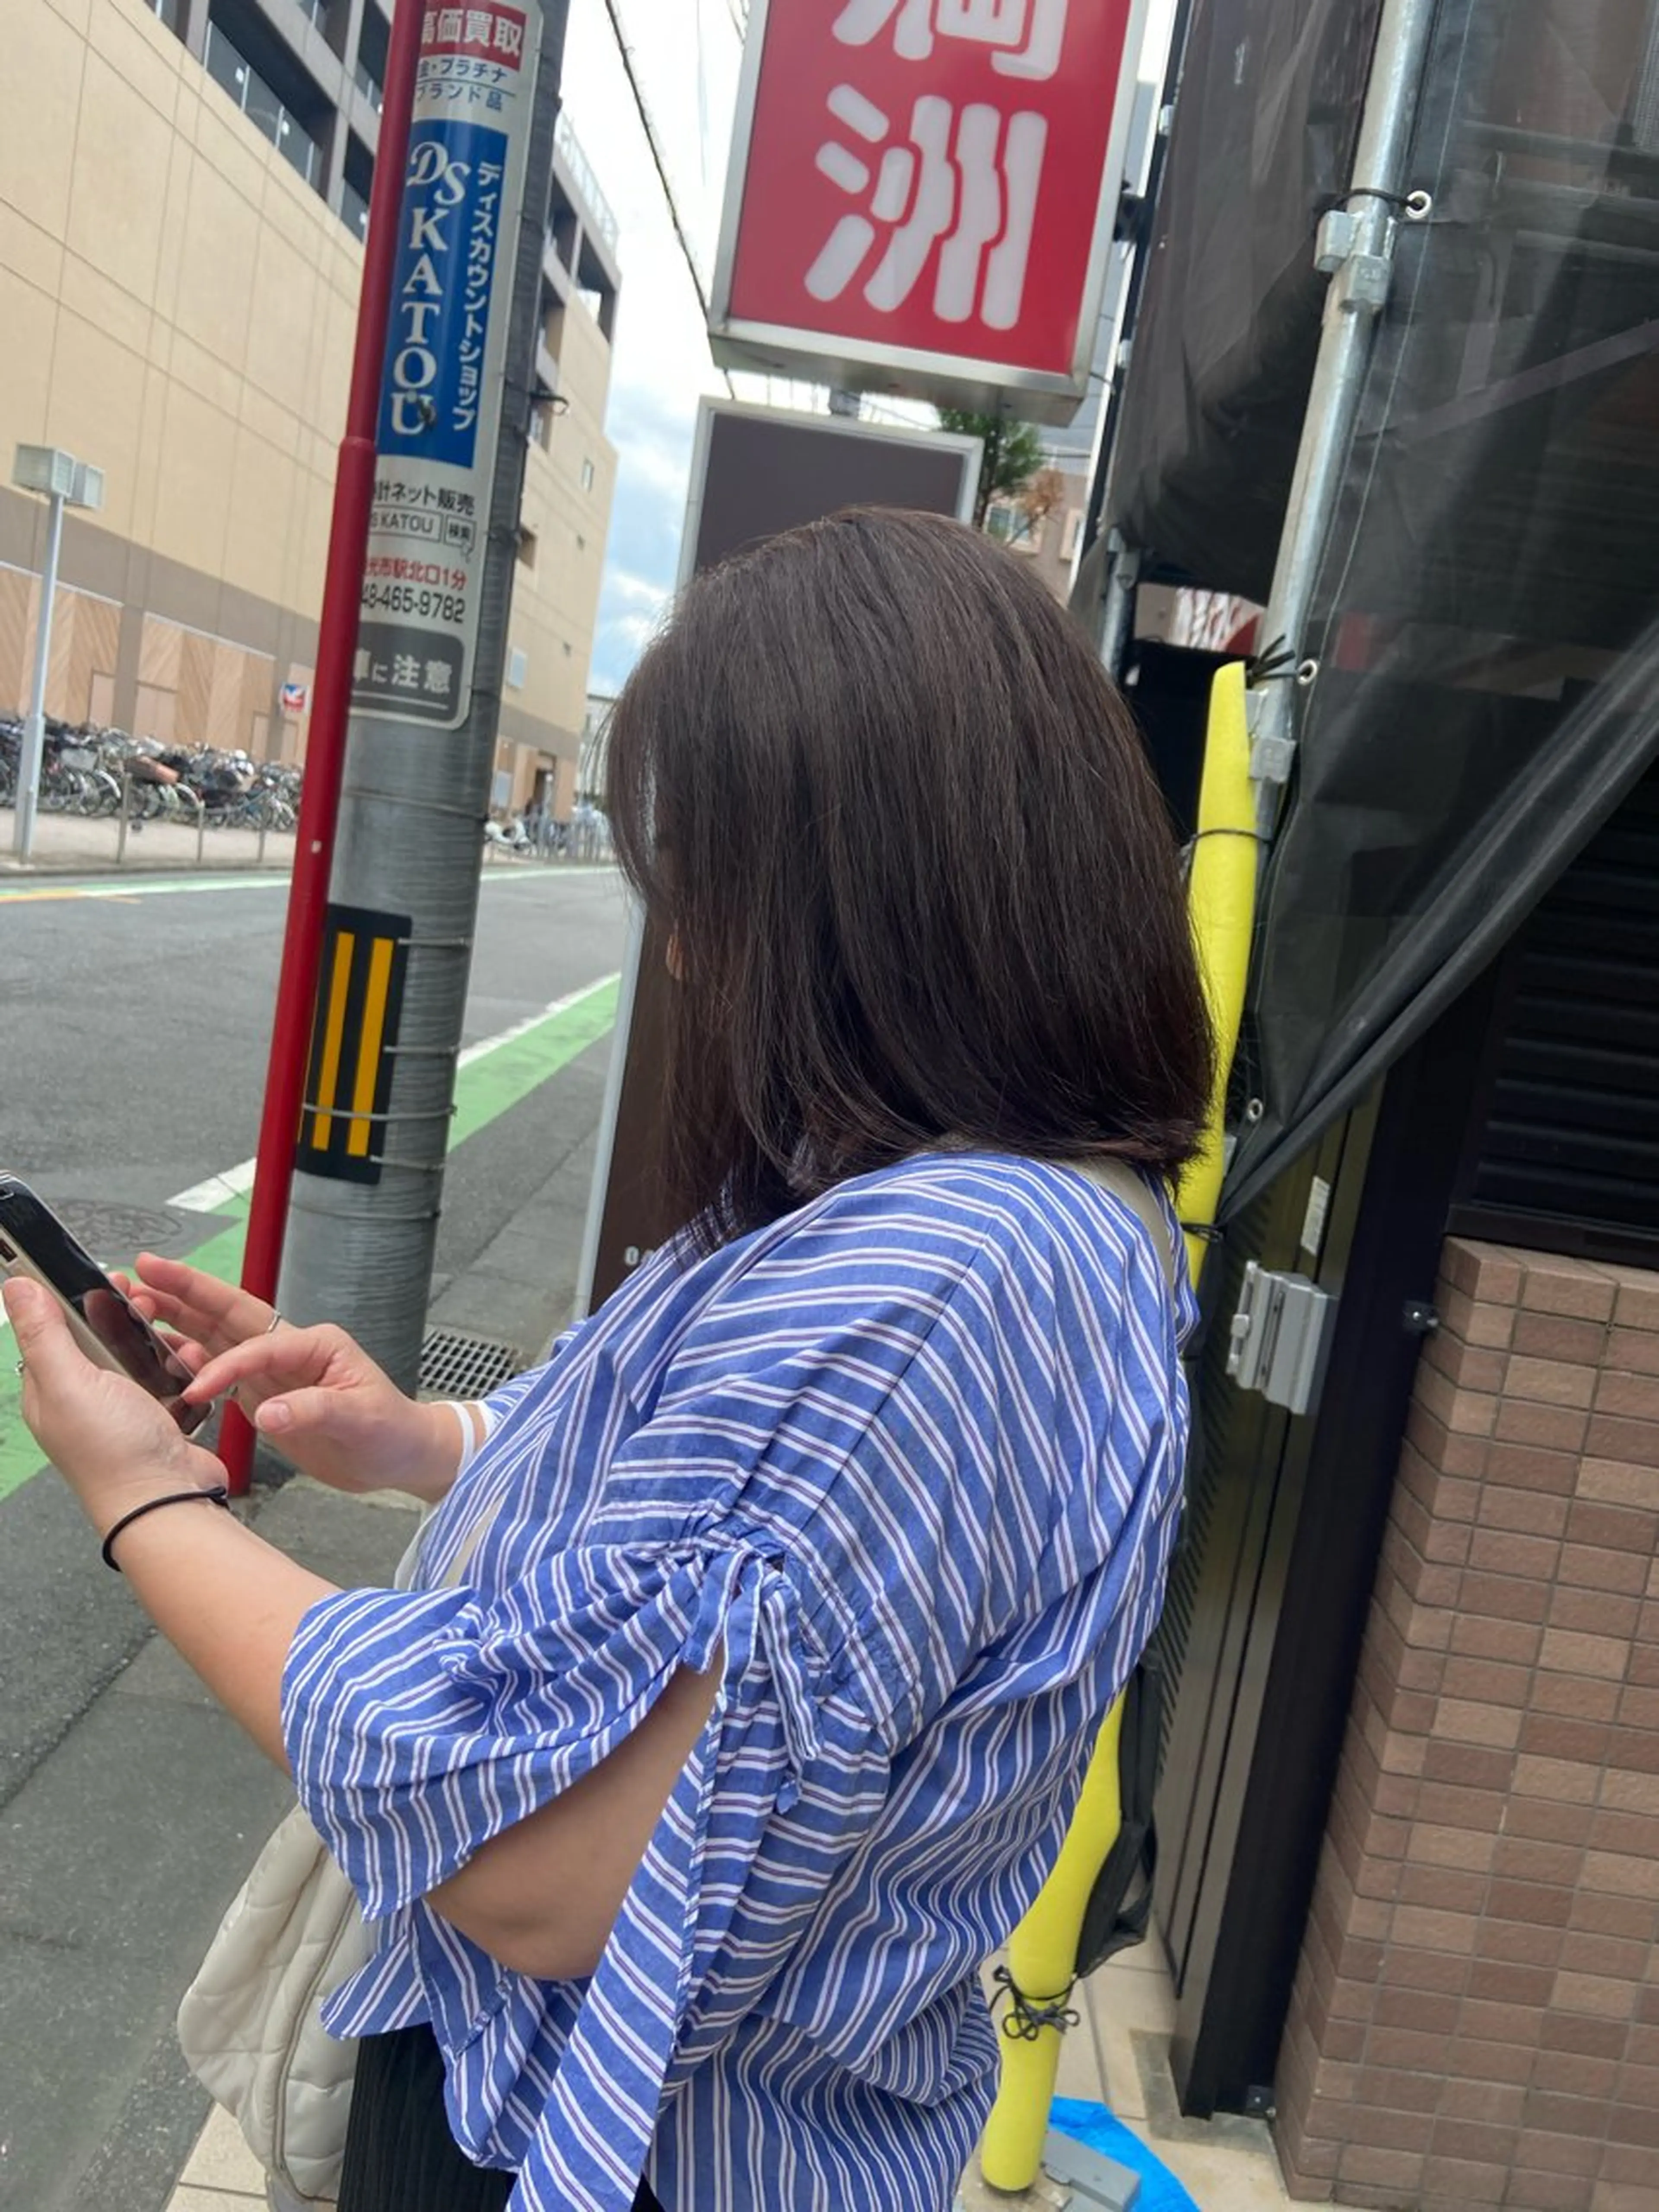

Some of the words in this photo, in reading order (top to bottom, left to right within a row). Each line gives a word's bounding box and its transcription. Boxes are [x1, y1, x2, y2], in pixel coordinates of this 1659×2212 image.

[452, 161, 502, 431] ディスカウントショップ
[374, 479, 475, 516] 計ネット販売
[366, 556, 467, 591] 光市駅北口1分
[361, 582, 466, 623] 48-465-9782
